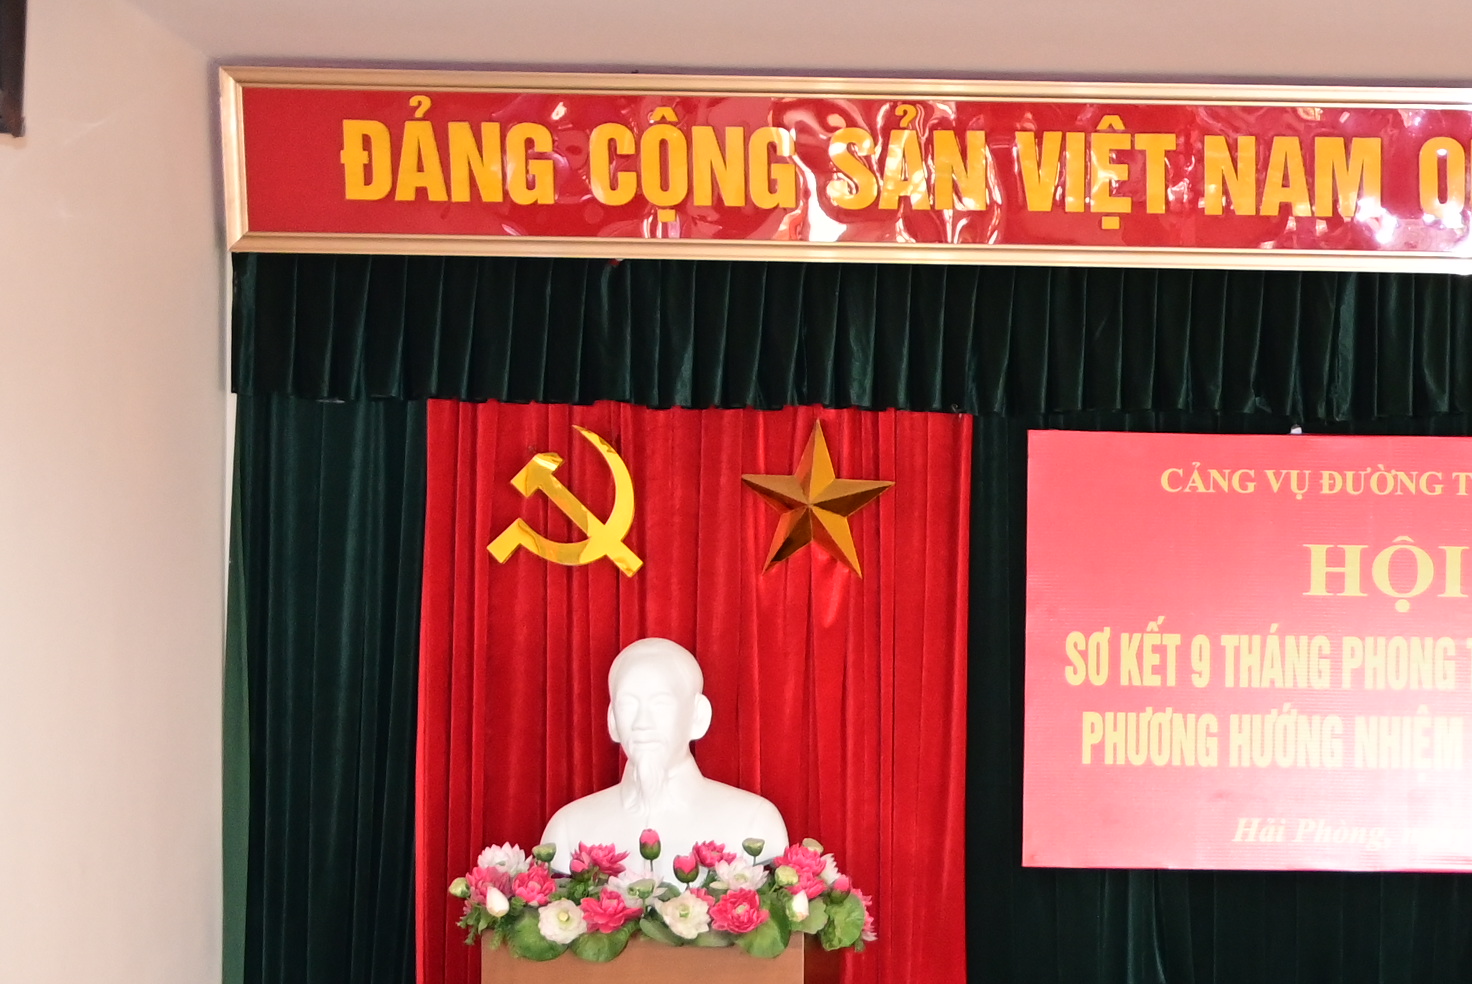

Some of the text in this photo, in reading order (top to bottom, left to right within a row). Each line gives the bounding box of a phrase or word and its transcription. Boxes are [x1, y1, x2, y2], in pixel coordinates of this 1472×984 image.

[340, 95, 556, 205] ĐẢNG
[589, 106, 796, 223] CỘNG
[828, 104, 987, 211] SẢN
[1015, 115, 1177, 229] VIỆT
[1203, 136, 1382, 217] NAM
[1160, 461, 1257, 493] CẢNG
[1264, 469, 1312, 500] VỤ
[1319, 464, 1445, 495] ĐƯỜNG
[1302, 535, 1470, 613] HỘI
[1064, 627, 1111, 686] SƠ
[1120, 616, 1182, 687] KẾT
[1190, 634, 1211, 688] 9
[1220, 623, 1332, 689] THÁNG
[1341, 636, 1457, 691] PHONG
[1081, 706, 1219, 767] PHƯƠNG
[1229, 702, 1344, 768] HƯỚNG
[1232, 817, 1287, 843] Hải
